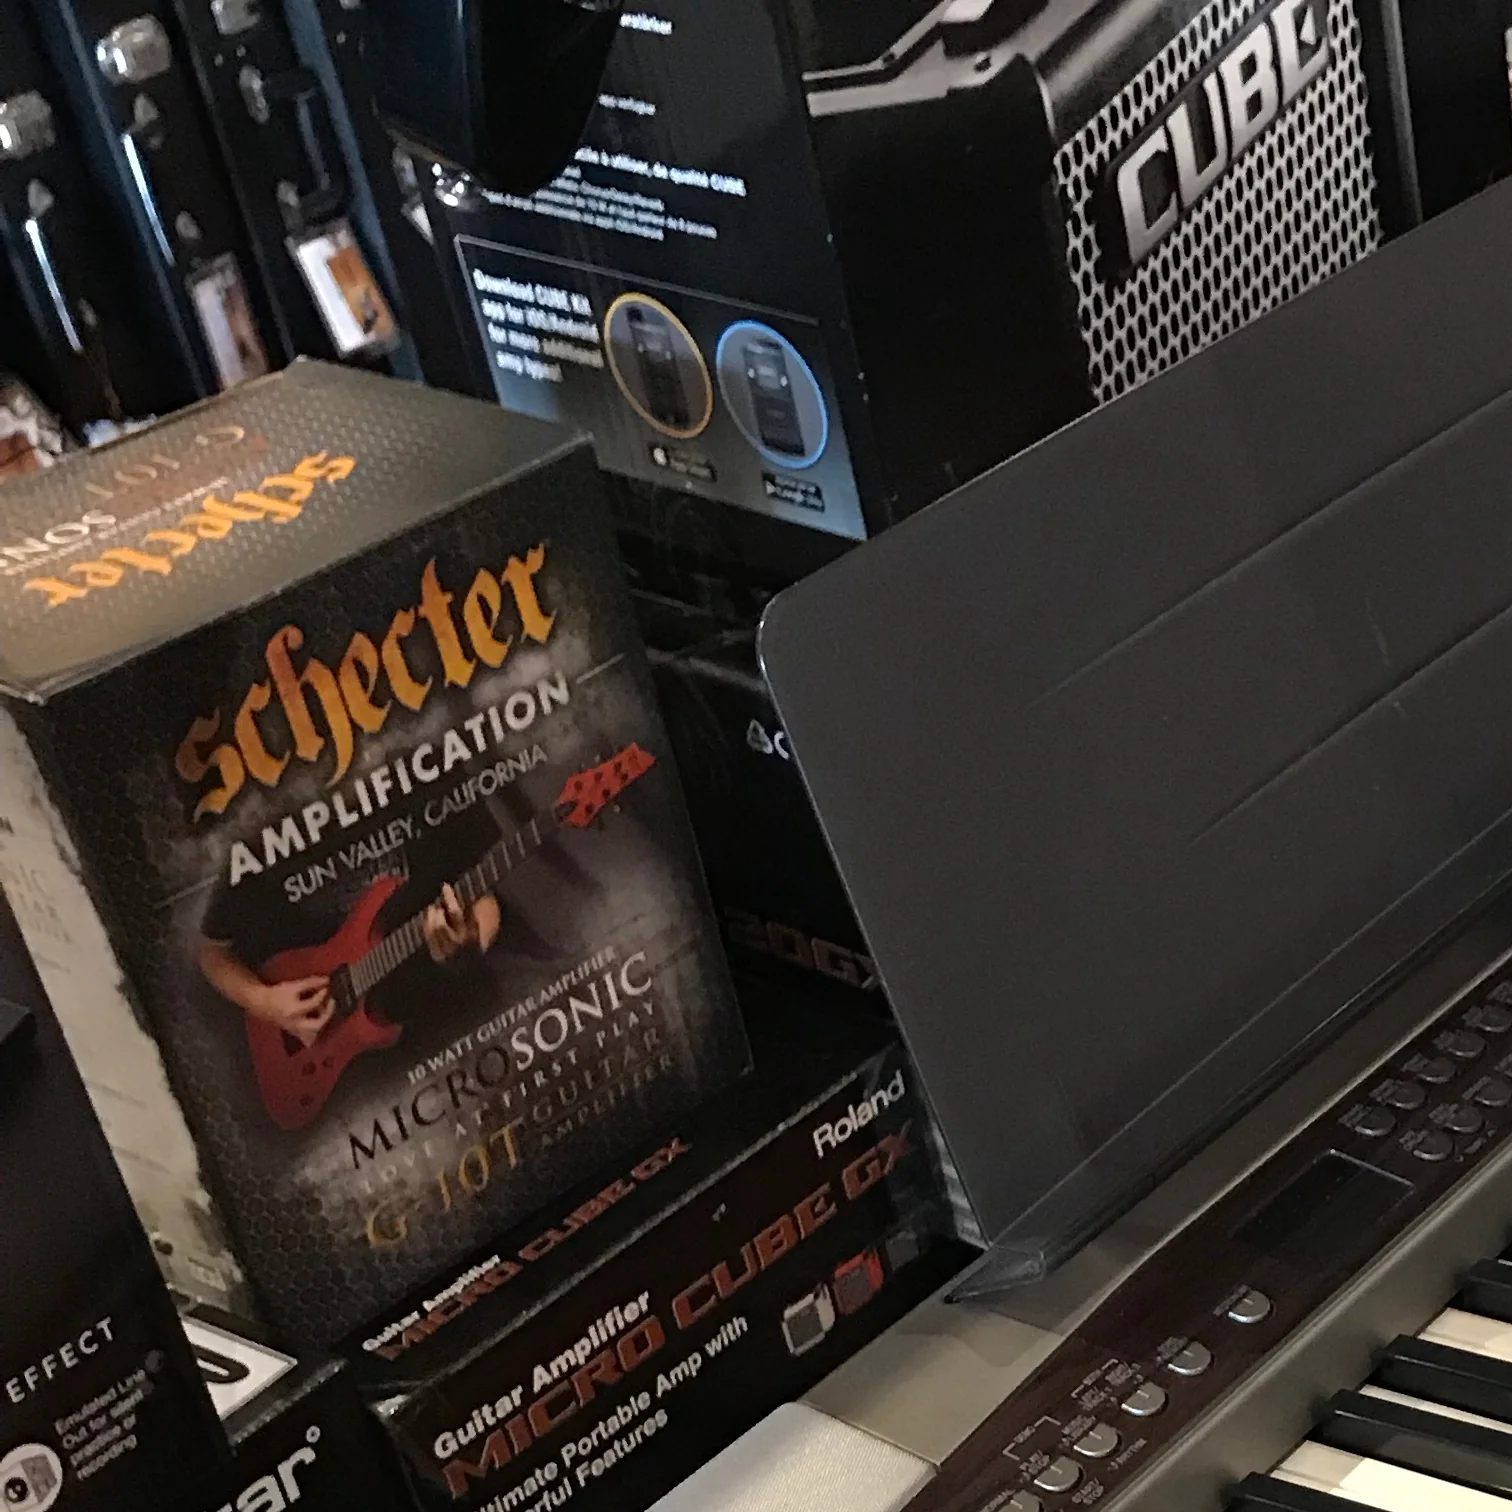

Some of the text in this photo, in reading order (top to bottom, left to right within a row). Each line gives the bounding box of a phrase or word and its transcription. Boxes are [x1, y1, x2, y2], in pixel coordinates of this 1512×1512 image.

[1117, 0, 1330, 264] CUBE
[229, 672, 570, 886] AMPLIFICATION
[284, 744, 548, 902] SUN VALLEY, CALIFORNIA
[348, 951, 652, 1170] MICROSONIC
[407, 945, 618, 1085] 10 WATT GUITAR AMPLIFIER
[501, 1046, 579, 1109] FIRST
[595, 1001, 656, 1049] PLAY
[532, 1027, 661, 1124] GUITAR
[813, 1068, 905, 1159] Roland
[376, 1136, 692, 1361] MICRO CUBE GX
[442, 1118, 913, 1499] MICRO CUBE GX
[5, 1316, 115, 1403] EFFECT
[52, 1387, 120, 1434] Emulated
[433, 1290, 649, 1459] Guitar Amplifier
[560, 1391, 651, 1468] Portable
[655, 1350, 702, 1398] Amp
[704, 1314, 749, 1358] with
[59, 1424, 90, 1451] Out
[575, 1407, 668, 1488] Features
